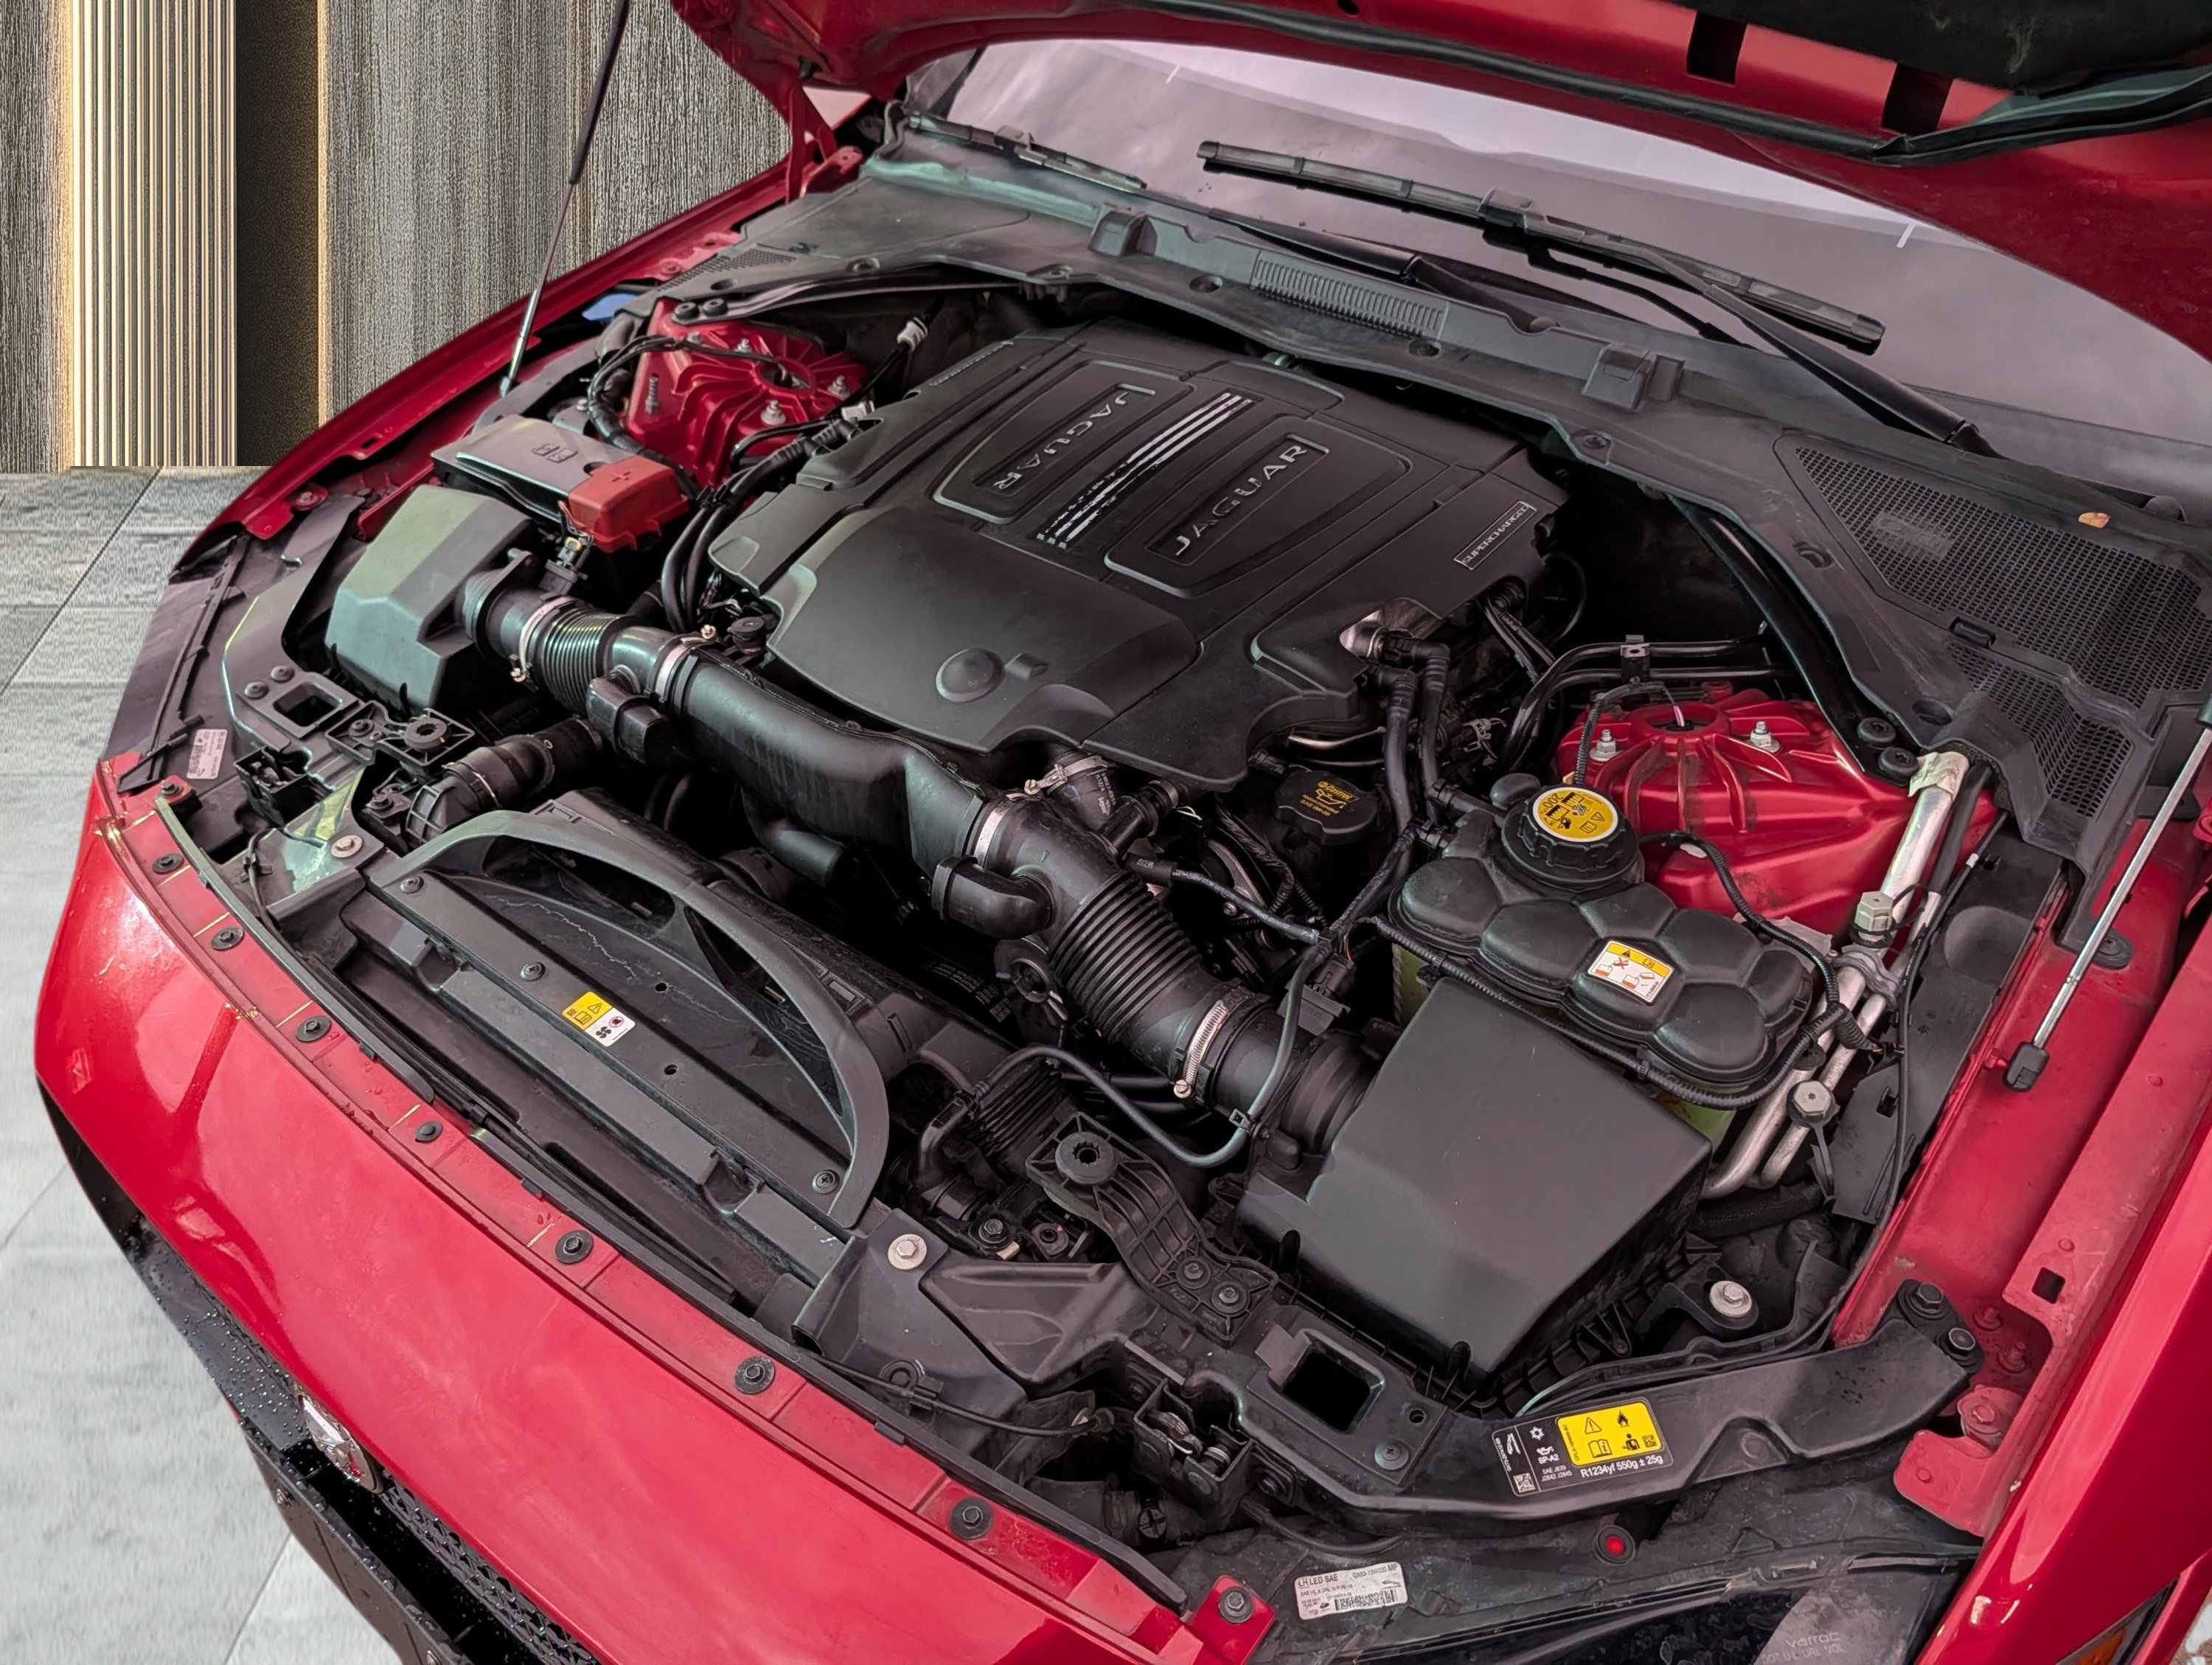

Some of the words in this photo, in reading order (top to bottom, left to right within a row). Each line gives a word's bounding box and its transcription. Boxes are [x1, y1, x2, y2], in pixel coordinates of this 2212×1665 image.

[992, 391, 1129, 490] JAGUAR
[1175, 445, 1308, 557] JAGUAR
[1461, 504, 1530, 566] SUPERCHARGED
[1325, 785, 1352, 800] Castrol
[1538, 1453, 1560, 1464] SP-A2
[1580, 1464, 1616, 1478] R1234yf
[1616, 1459, 1638, 1473] 550g
[1646, 1454, 1663, 1466] 25g
[1542, 1466, 1554, 1475] SAE
[1298, 1579, 1309, 1588] LH
[1310, 1576, 1324, 1585] LED
[1325, 1574, 1339, 1583] SAE
[1785, 1632, 1841, 1647] varroc
